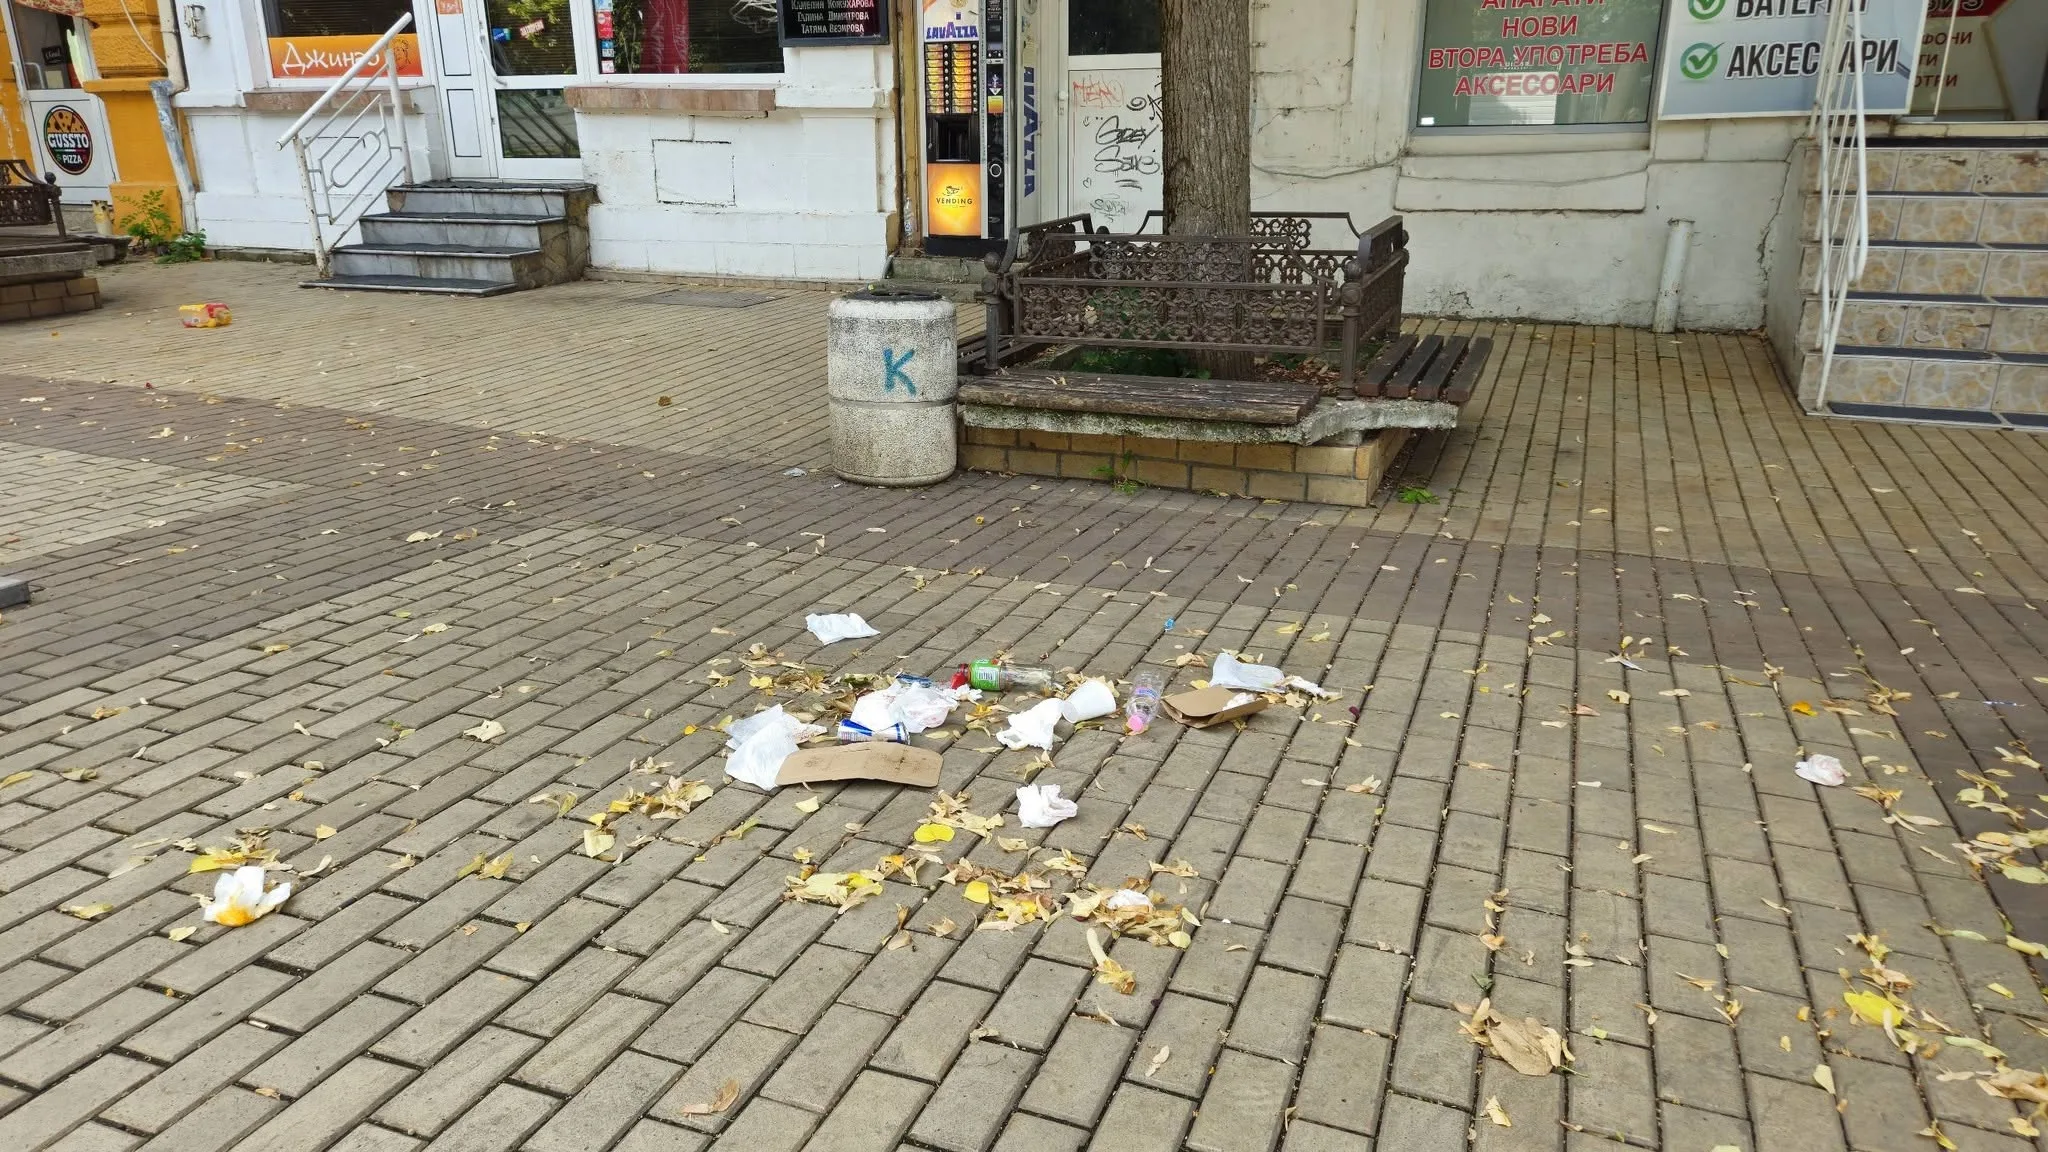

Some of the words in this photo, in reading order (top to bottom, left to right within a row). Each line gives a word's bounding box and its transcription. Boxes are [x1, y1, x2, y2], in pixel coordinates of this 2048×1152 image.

[926, 21, 979, 39] LAVAZZA
[1502, 15, 1578, 38] НОВИ
[1428, 46, 1506, 69] ВТОРА
[1513, 42, 1649, 67] УПОТРЕБА
[1726, 39, 1899, 78] АКСЕСАРИ
[1453, 72, 1615, 96] АКСЕСОАРИ
[47, 133, 90, 149] GUSSTO
[62, 154, 84, 165] PIZZA
[936, 197, 973, 205] VENDING
[882, 347, 917, 397] K
